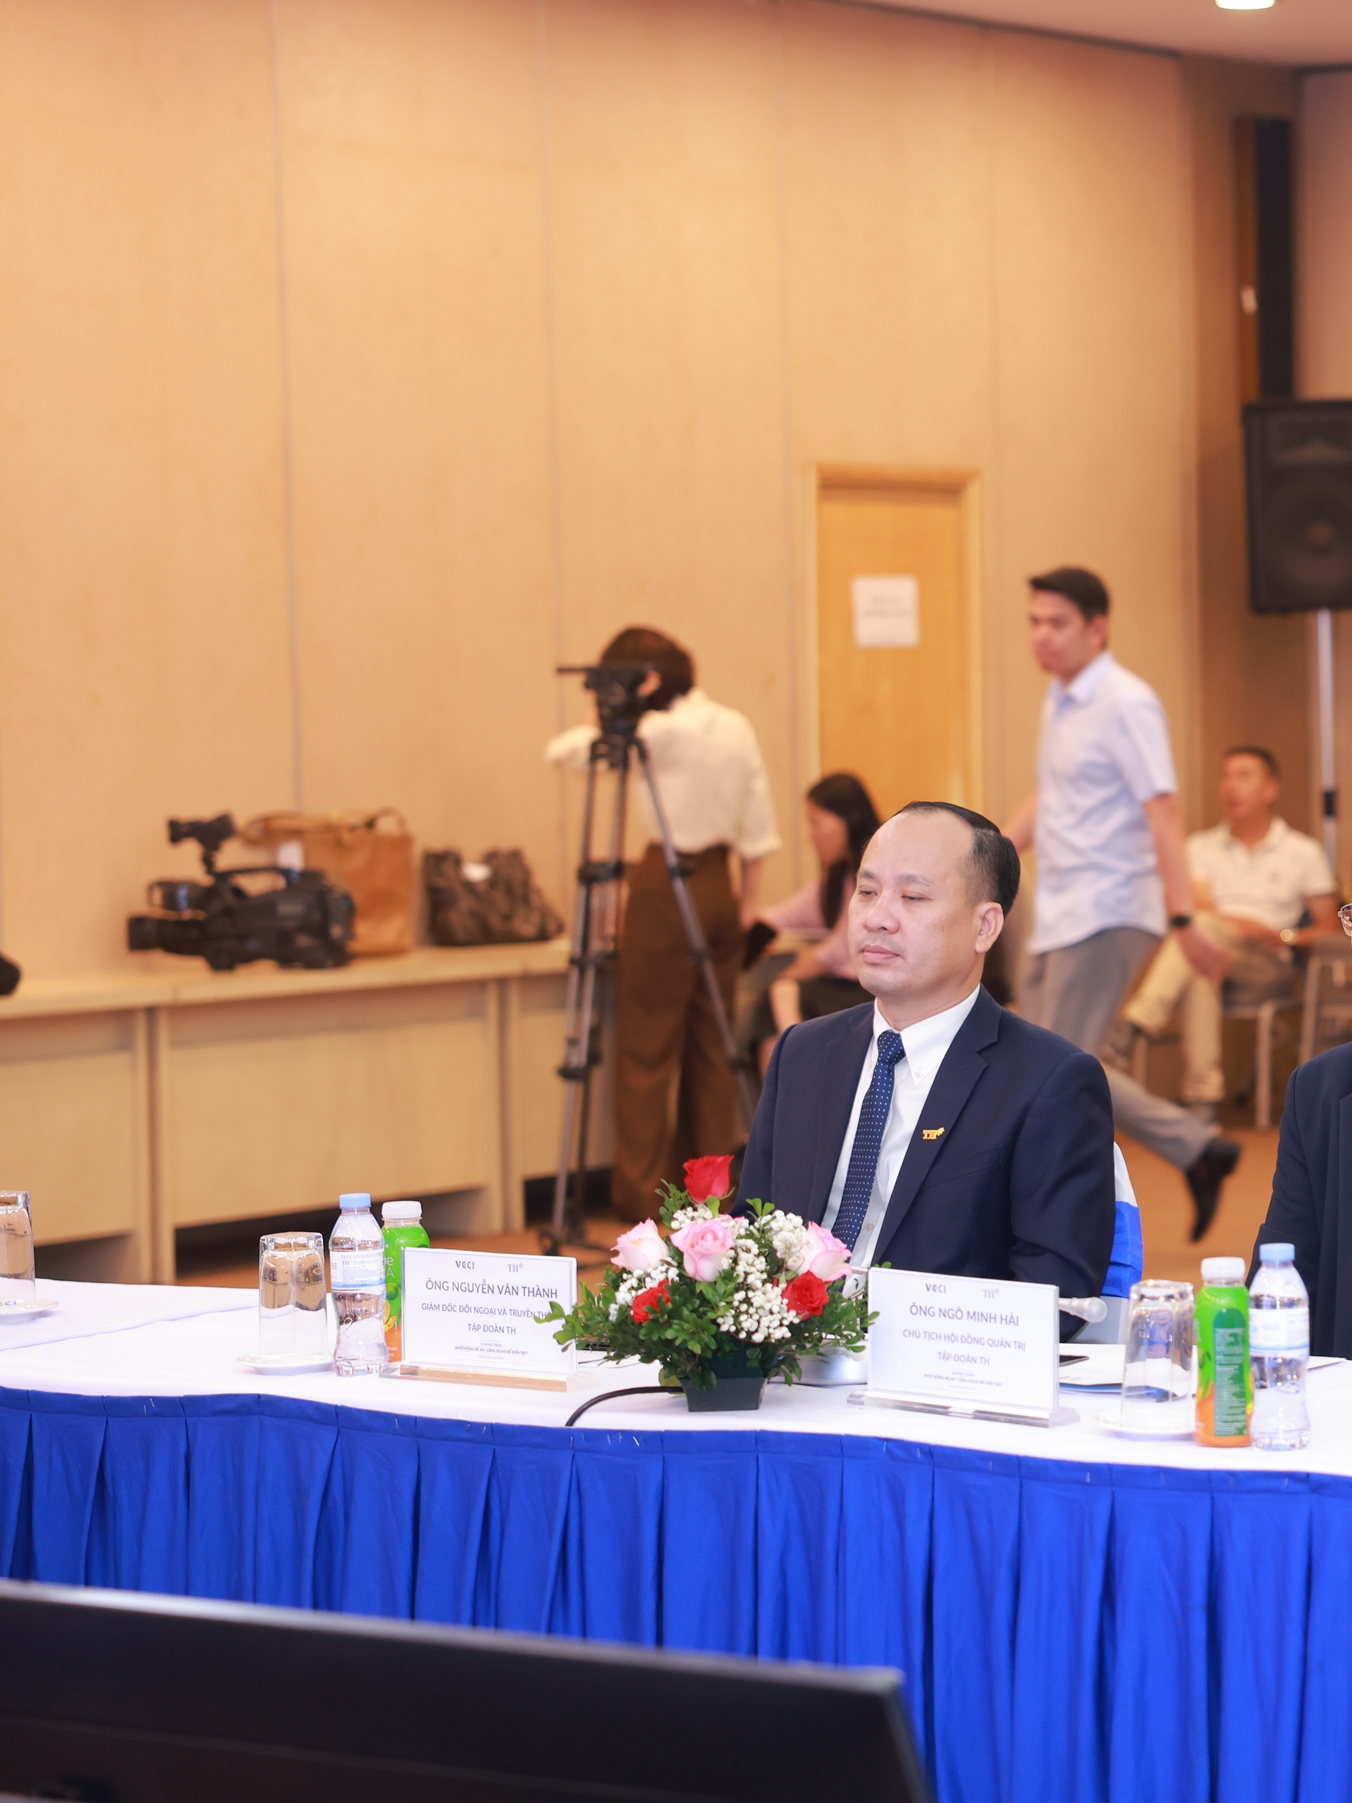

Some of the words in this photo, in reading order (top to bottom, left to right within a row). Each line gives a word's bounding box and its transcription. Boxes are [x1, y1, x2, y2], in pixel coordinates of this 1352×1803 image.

[455, 1260, 475, 1270] VCCI
[426, 1278, 449, 1291] ÔNG
[452, 1278, 494, 1294] NGUYỄN
[497, 1283, 519, 1296] VĂN
[522, 1284, 558, 1299] THÀNH
[925, 1283, 946, 1294] VCCI
[422, 1302, 440, 1311] GIÁM
[442, 1303, 458, 1312] ĐỐC
[458, 1304, 472, 1314] ĐỐI
[474, 1306, 496, 1316] NGOẠI
[498, 1308, 508, 1316] VÀ
[509, 1308, 536, 1318] TRUYỀN
[910, 1302, 936, 1318] ÔNG
[938, 1306, 964, 1320] NGÔ
[966, 1310, 997, 1324] MINH
[1000, 1312, 1019, 1326] HẢI
[468, 1322, 482, 1334] TẬP
[483, 1324, 504, 1334] ĐOÀN
[506, 1326, 516, 1334] TH
[902, 1328, 921, 1339] CHỦ
[923, 1330, 942, 1342] TỊCH
[944, 1332, 959, 1344] HỘI
[960, 1332, 986, 1346] ĐỒNG
[987, 1338, 1011, 1349] QUẢN
[1013, 1340, 1026, 1352] TRỊ
[938, 1350, 952, 1362] TẬP
[954, 1352, 977, 1364] ĐOÀN
[979, 1356, 990, 1366] TH
